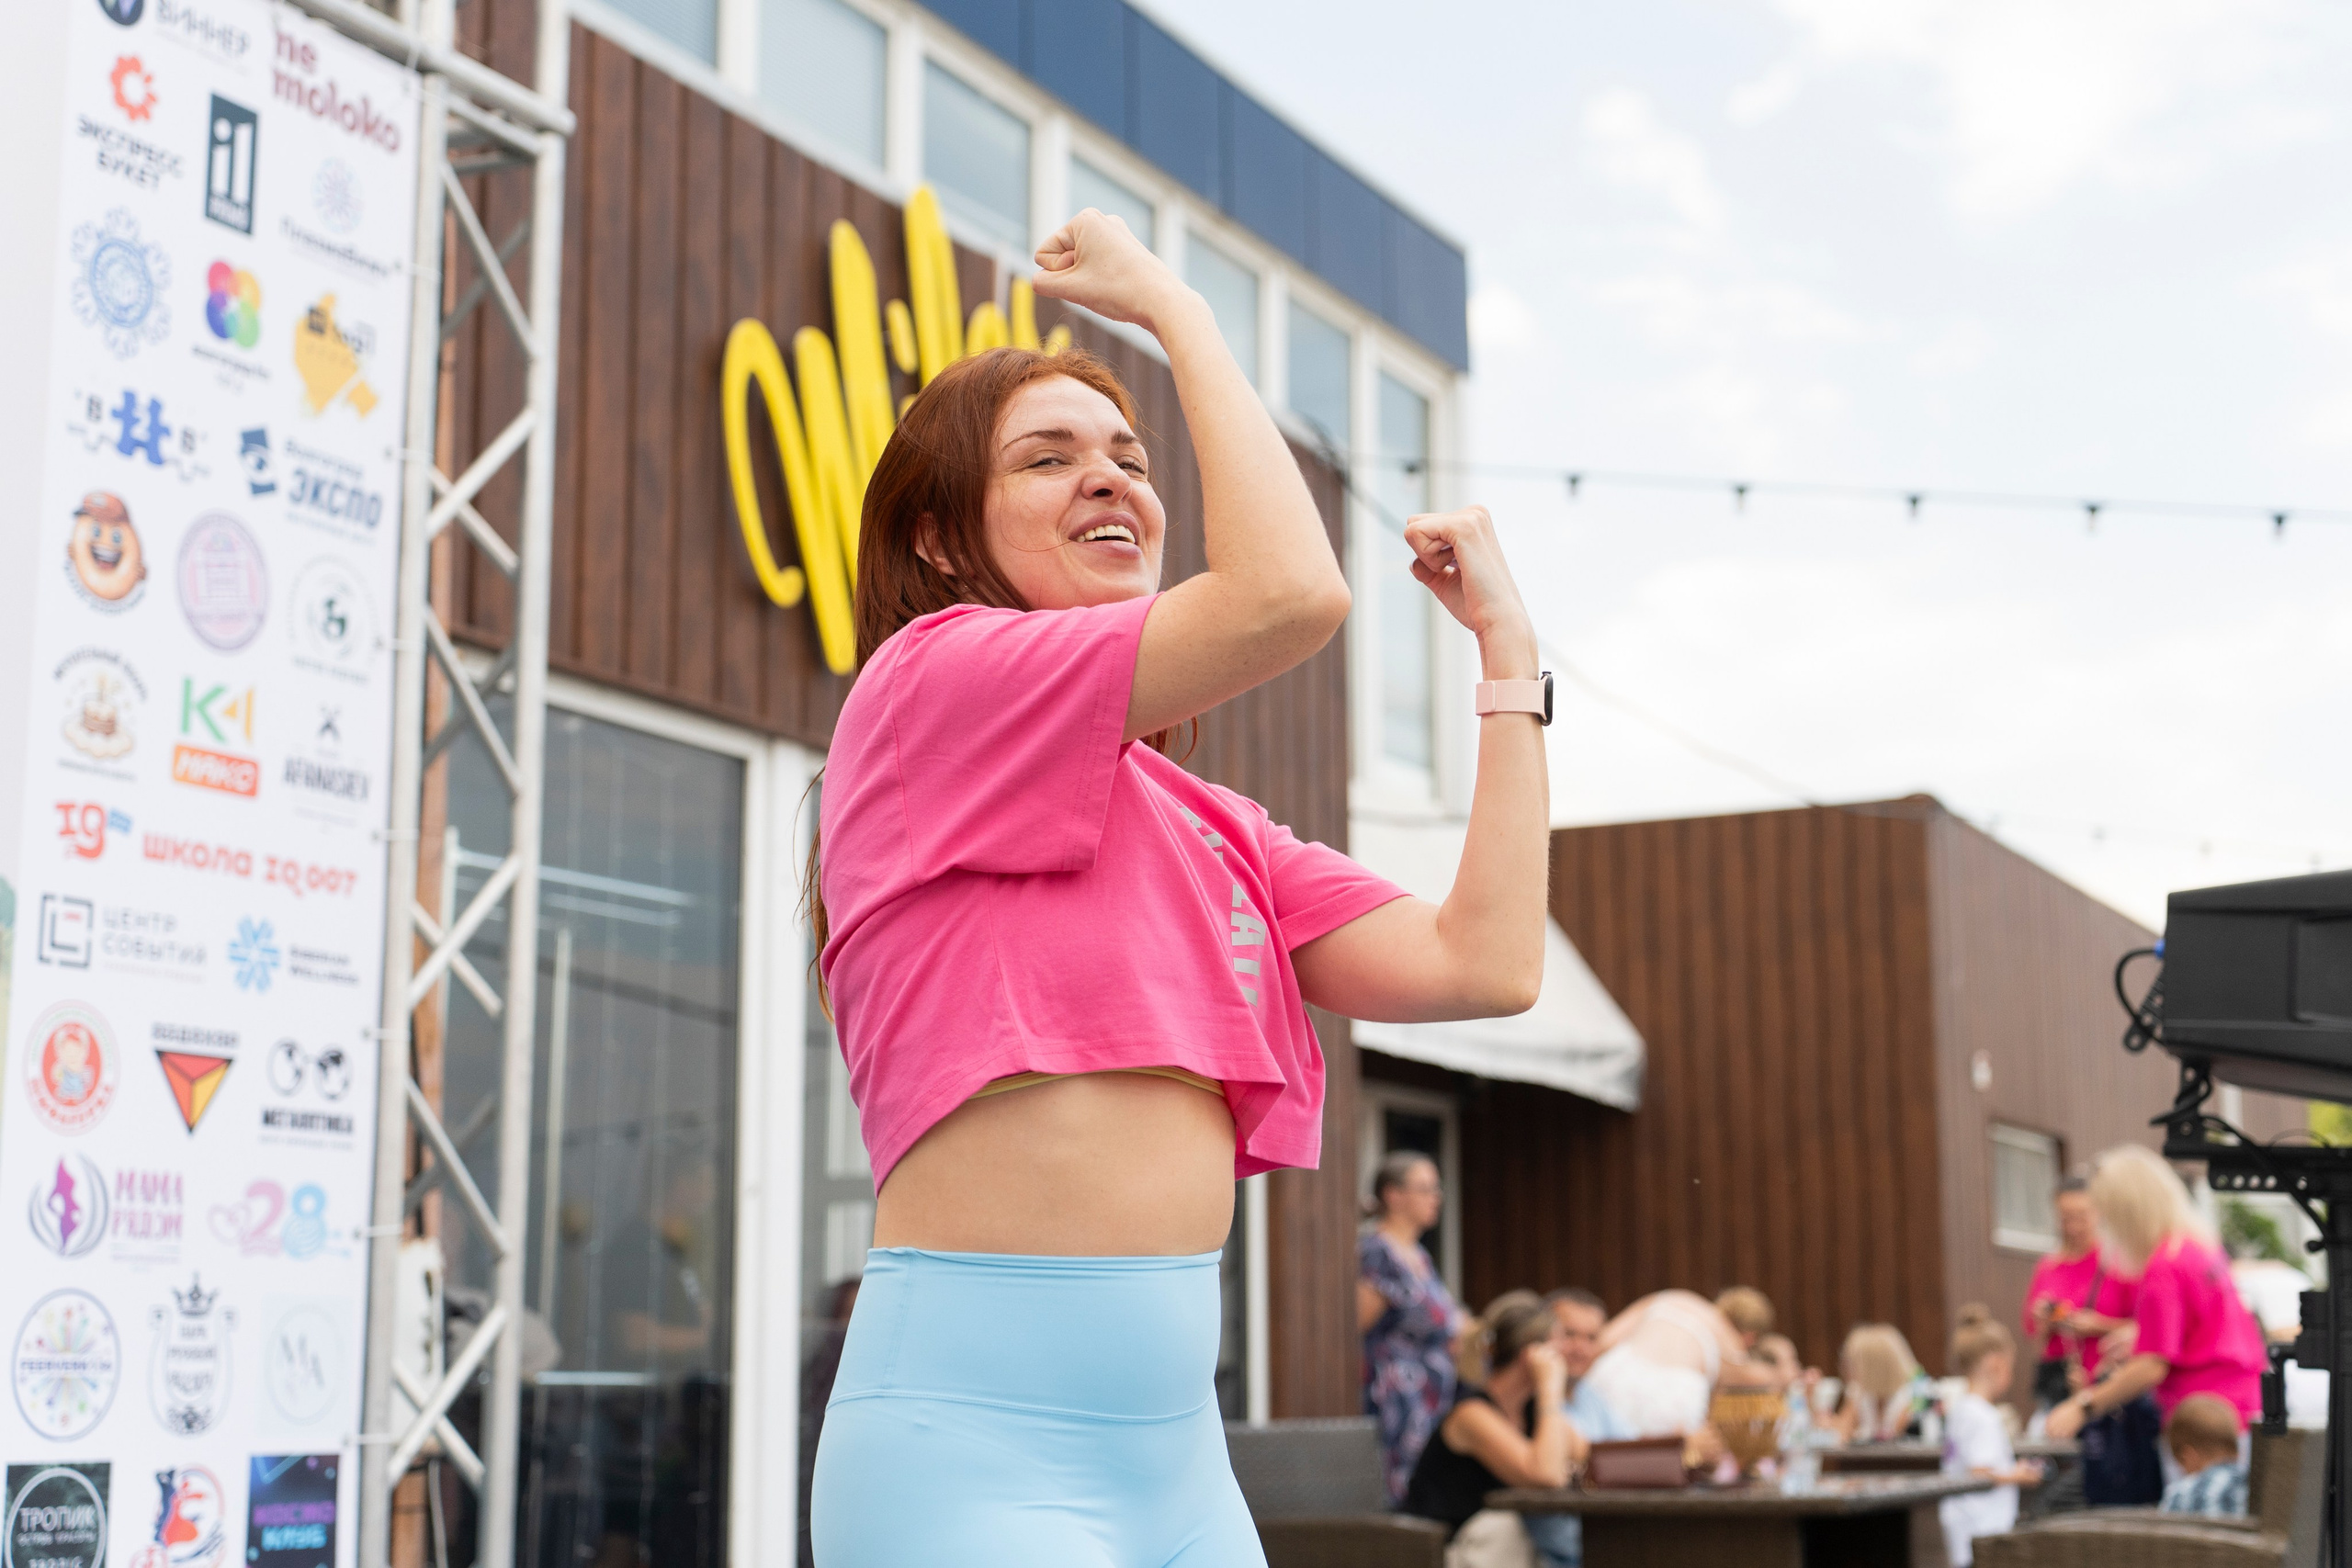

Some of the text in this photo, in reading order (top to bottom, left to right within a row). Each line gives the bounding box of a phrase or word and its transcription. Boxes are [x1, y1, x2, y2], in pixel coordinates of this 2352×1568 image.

[274, 68, 401, 153] moloko
[288, 467, 382, 529] ЭКСПО
[103, 906, 178, 934] ЦЕНТР
[101, 931, 208, 966] СОБЫТИЙ
[18, 1505, 96, 1532] ТРОПИК
